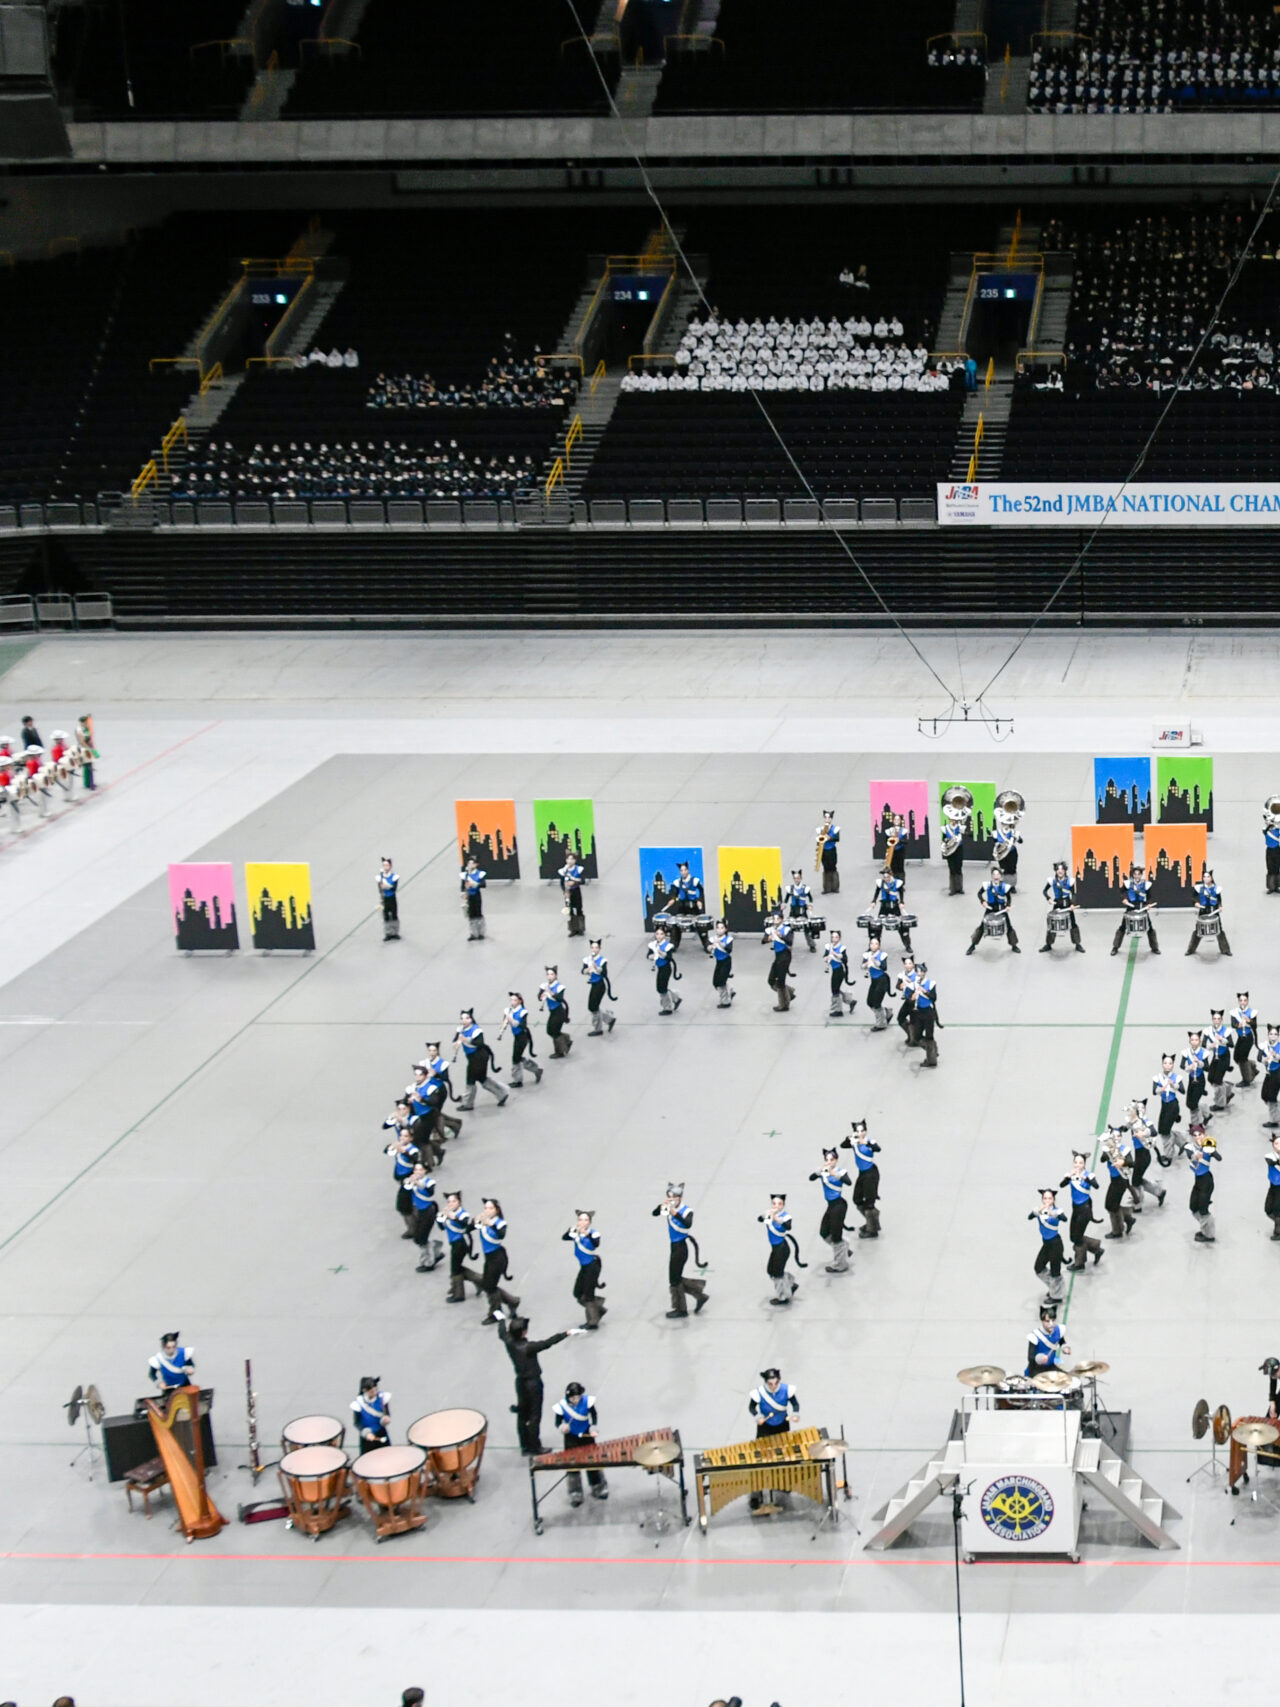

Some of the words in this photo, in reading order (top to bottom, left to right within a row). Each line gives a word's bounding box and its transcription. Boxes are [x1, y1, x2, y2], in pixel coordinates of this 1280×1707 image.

[614, 291, 632, 300] 234
[980, 288, 999, 298] 235
[989, 494, 1023, 512] The
[1066, 494, 1119, 515] JMBA
[1122, 494, 1226, 512] NATIONAL
[988, 1521, 1048, 1541] ASSOCIATION
